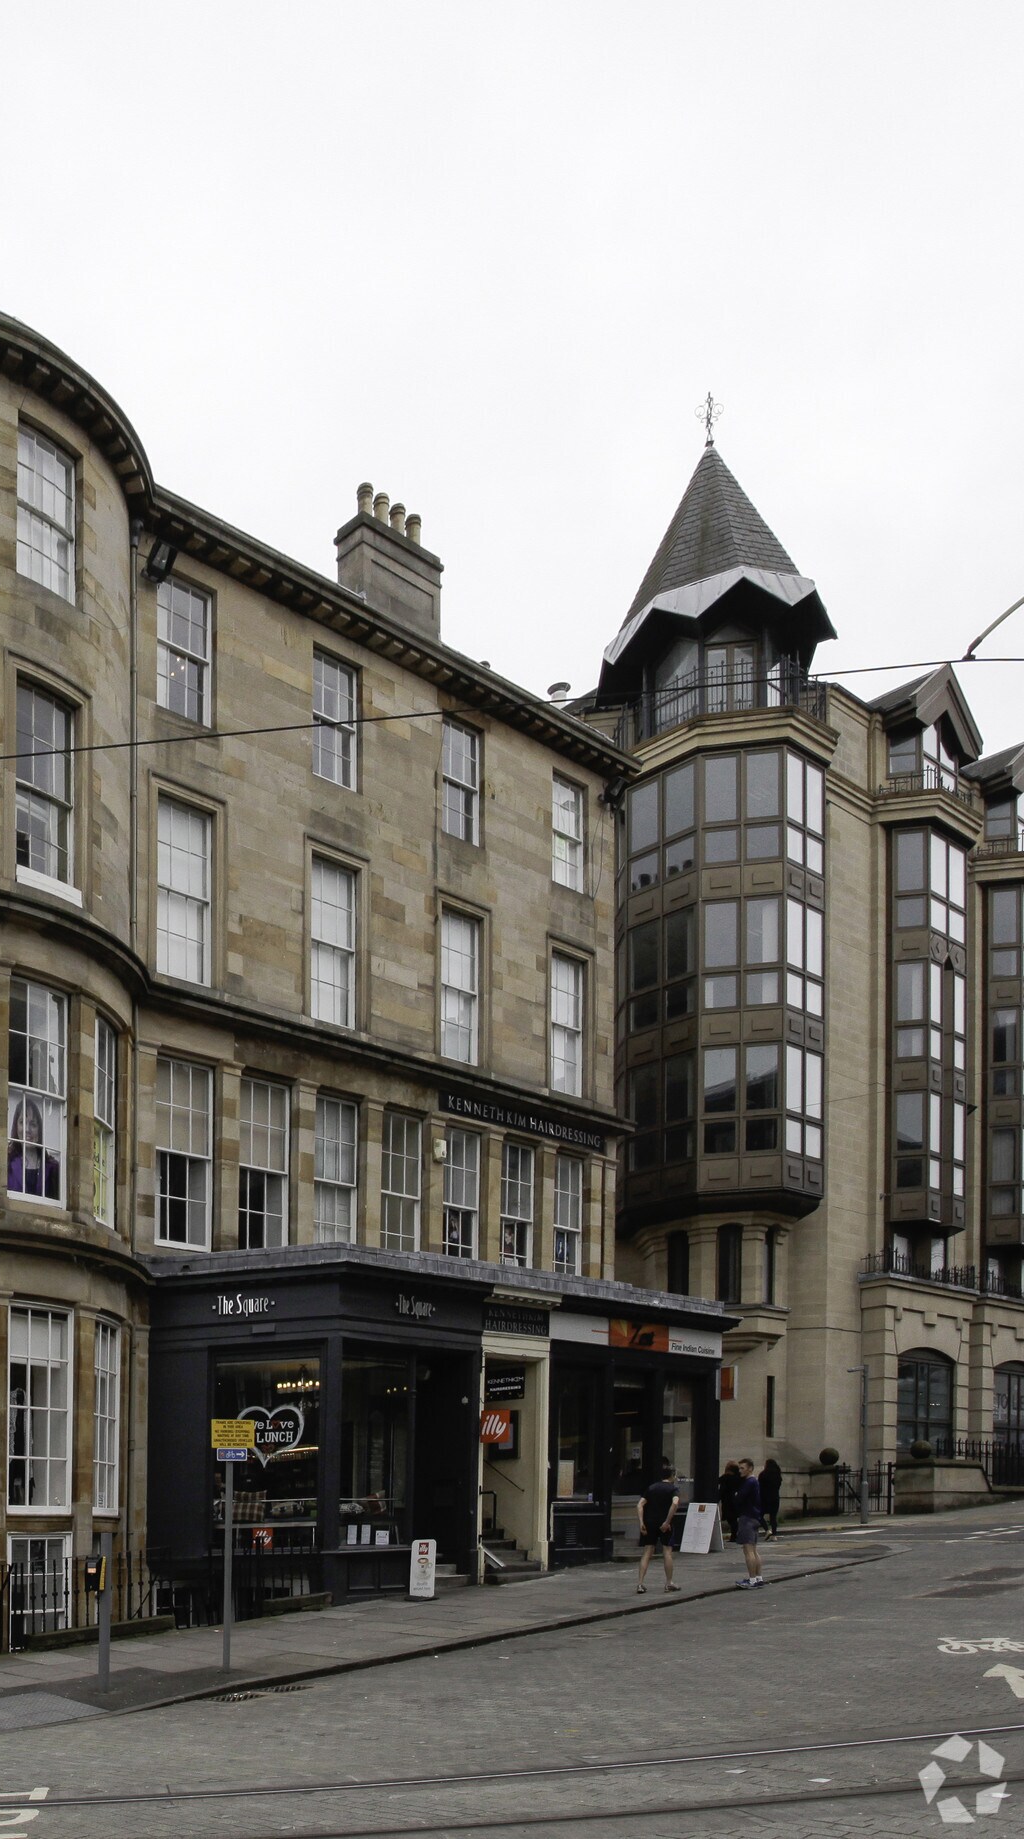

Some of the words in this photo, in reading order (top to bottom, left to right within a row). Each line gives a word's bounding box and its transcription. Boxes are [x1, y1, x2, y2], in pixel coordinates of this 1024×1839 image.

[530, 1117, 600, 1148] HAIRDRESSING
[217, 1296, 233, 1315] The
[236, 1294, 268, 1316] Square
[398, 1294, 410, 1314] The
[410, 1296, 432, 1320] Square
[485, 1320, 547, 1335] HAIRDRESSING
[671, 1342, 682, 1352] Fine
[682, 1344, 697, 1353] Indian
[698, 1346, 716, 1356] Cuisine
[256, 1432, 294, 1443] LUNCH
[482, 1414, 507, 1440] illy
